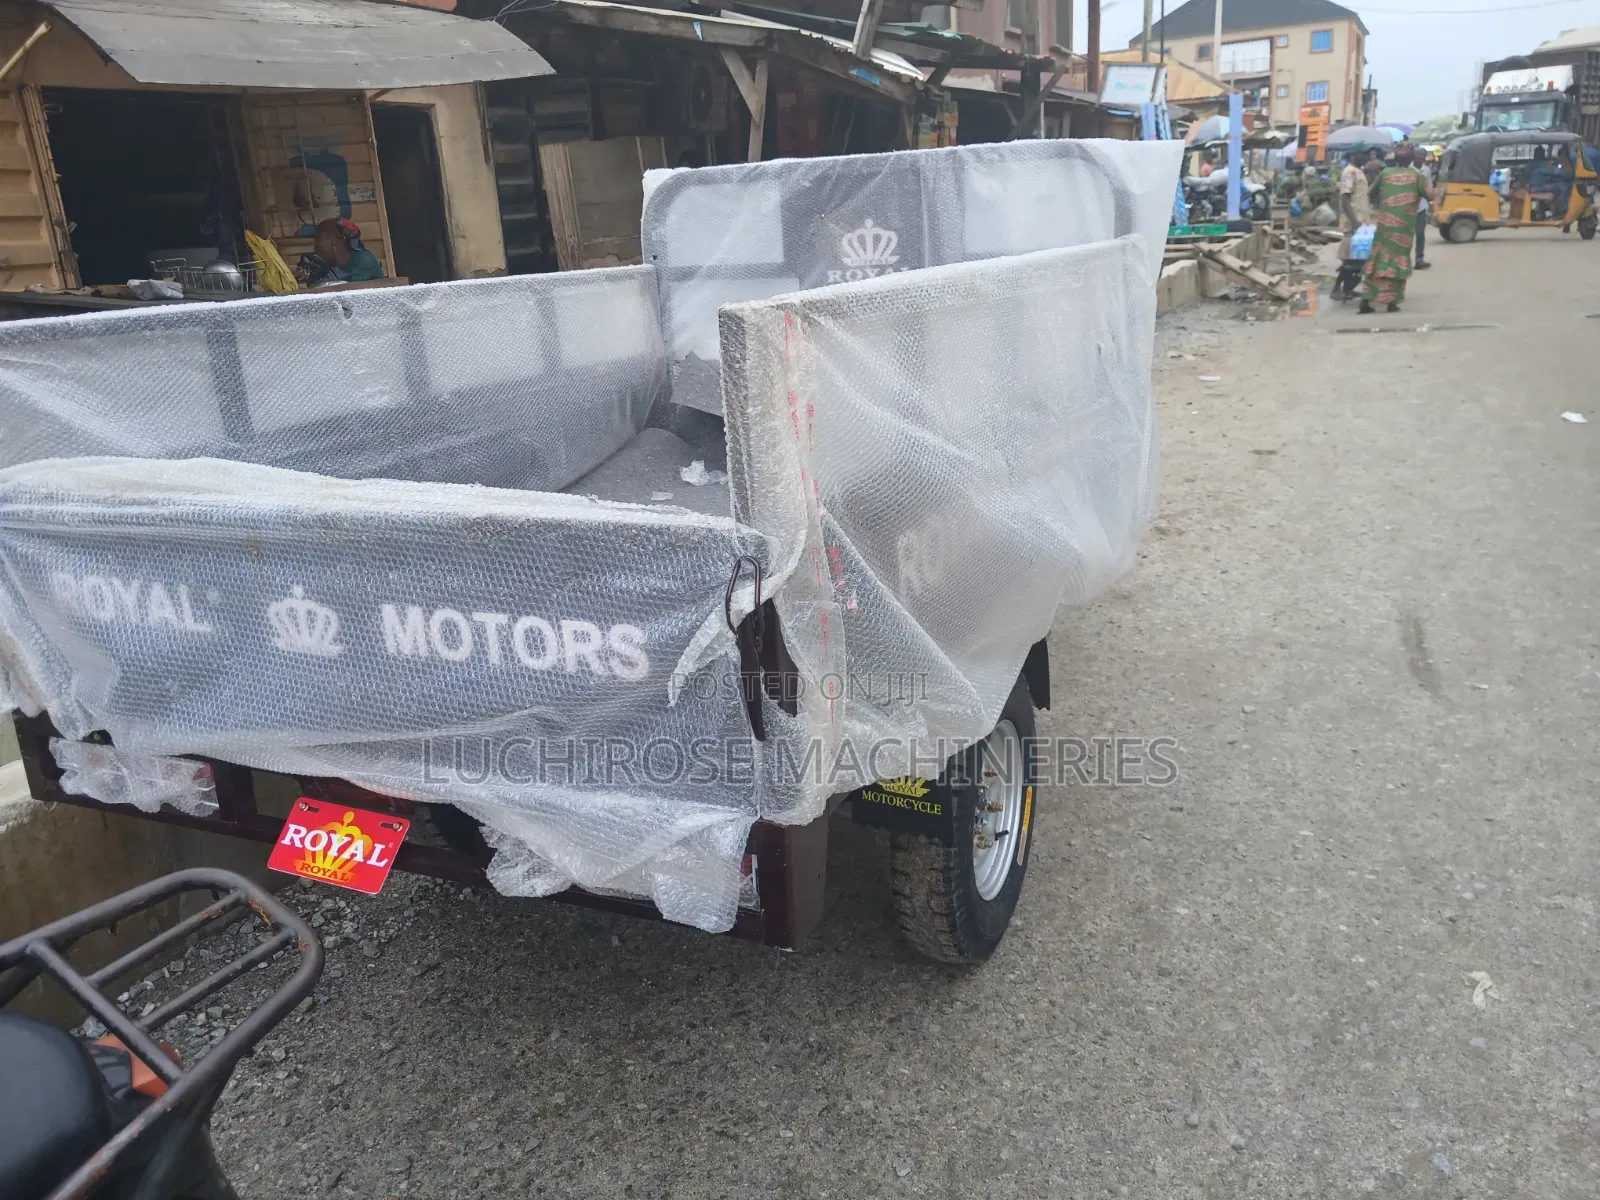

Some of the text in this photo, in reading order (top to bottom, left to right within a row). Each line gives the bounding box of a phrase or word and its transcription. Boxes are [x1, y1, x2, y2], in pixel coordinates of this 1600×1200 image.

[827, 267, 910, 283] ROY
[381, 603, 650, 681] MOTORS
[884, 782, 921, 796] ROYAL
[862, 789, 942, 816] MOTORCYCLE
[280, 823, 390, 868] ROYAL
[299, 862, 350, 882] ROYAL
